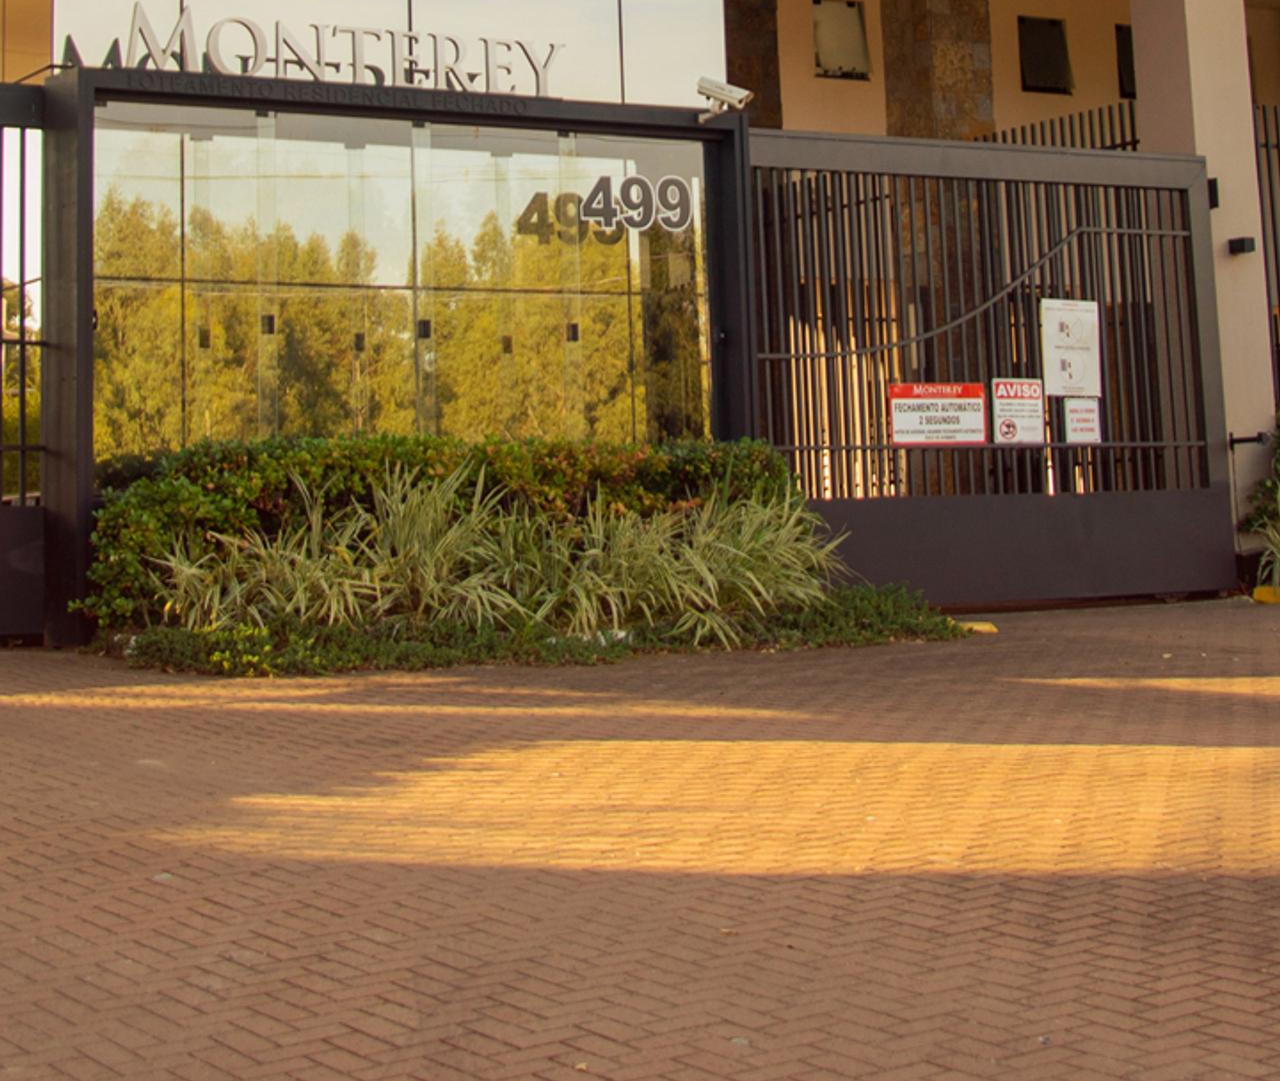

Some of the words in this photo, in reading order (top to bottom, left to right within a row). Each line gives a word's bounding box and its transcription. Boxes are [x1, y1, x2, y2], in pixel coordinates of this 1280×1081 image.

[126, 0, 567, 99] MONTEREY
[283, 86, 420, 109] RESIDENCIAL
[431, 93, 527, 114] FECHADO
[580, 175, 692, 232] 499
[997, 383, 1041, 397] AVISO
